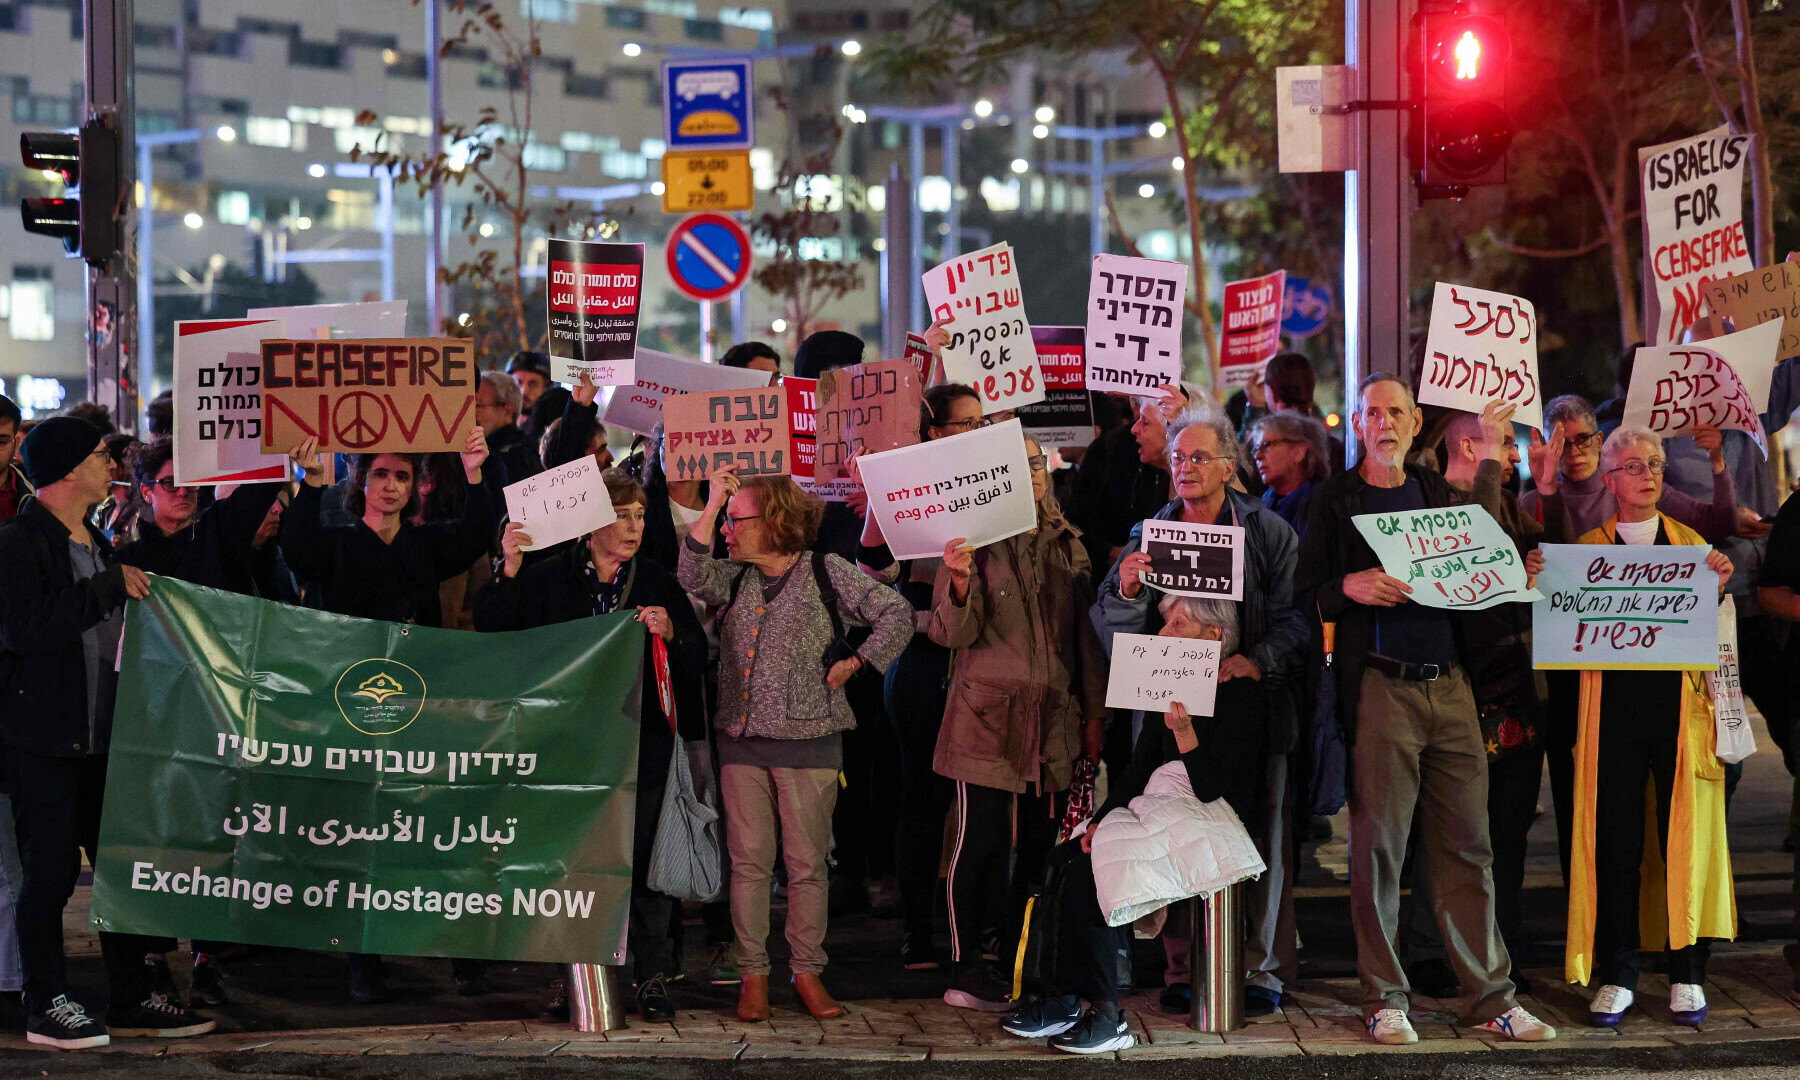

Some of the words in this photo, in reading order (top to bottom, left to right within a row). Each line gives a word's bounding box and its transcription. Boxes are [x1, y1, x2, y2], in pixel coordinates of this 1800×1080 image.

[1649, 136, 1748, 191] ISRAELIS
[1674, 183, 1721, 231] FOR
[1654, 221, 1748, 281] CEASEFIRE
[553, 269, 576, 286] כולם
[613, 273, 637, 288] כולם
[946, 250, 1010, 295] פדיון
[1100, 271, 1177, 302] הסדר
[1237, 284, 1275, 309] לעצור
[553, 292, 574, 306] الكل
[612, 295, 635, 309] الكل
[935, 288, 1020, 322] שבויים
[1097, 298, 1173, 329] מדיני
[1228, 308, 1260, 329] האש
[1450, 287, 1531, 344] לסבל
[945, 319, 1024, 356] הפסקת
[1114, 332, 1150, 362] די
[262, 342, 469, 389] CEASEFIRE
[980, 345, 1011, 370] אש
[1060, 353, 1082, 367] כולם
[197, 363, 260, 388] כולם
[636, 379, 660, 393] לדם
[851, 366, 897, 401] כולם
[1062, 373, 1083, 385] الكل
[1092, 366, 1172, 389] למלחמה
[1429, 350, 1537, 407] למלחמה
[197, 394, 261, 411] תמורת
[662, 386, 678, 397] דם
[708, 393, 780, 424] טבח
[822, 405, 883, 433] תמורת
[198, 416, 262, 441] כולם
[745, 421, 774, 445] לא
[668, 428, 738, 454] מצדיק
[550, 464, 590, 488] הפסקת
[955, 471, 988, 489] הבדל
[989, 463, 1010, 484] אין
[521, 483, 539, 498] אש
[886, 487, 911, 503] לדם
[913, 484, 931, 498] דם
[933, 480, 954, 497] בין
[973, 484, 1002, 508] فرق
[1002, 479, 1013, 494] لا
[893, 508, 922, 523] ودم
[924, 502, 946, 519] دم
[948, 496, 971, 514] بين
[1149, 527, 1187, 542] מדיני
[1376, 515, 1404, 536] אש
[1410, 510, 1473, 537] הפסקת
[1190, 530, 1233, 546] הסדר
[1170, 549, 1201, 570] די
[1586, 556, 1616, 584] אש
[1146, 571, 1231, 591] למלחמה
[1617, 562, 1697, 587] הפסקת
[1615, 592, 1643, 614] את
[1646, 593, 1699, 615] השיבו
[1572, 621, 1664, 653] עכשיו!
[1132, 645, 1148, 659] גם
[1161, 645, 1171, 657] לי
[1179, 647, 1216, 660] אכפת
[1151, 666, 1196, 680] האזרחים
[1203, 667, 1214, 679] על
[217, 730, 313, 769] עכשיו
[325, 745, 435, 773] שבויים
[447, 751, 538, 782] פידיון
[223, 803, 287, 837] الآن
[434, 816, 518, 852] تبادل
[130, 861, 294, 911] Exchange
[302, 878, 339, 909] of
[347, 881, 503, 922] Hostages
[512, 887, 595, 920] NOW
